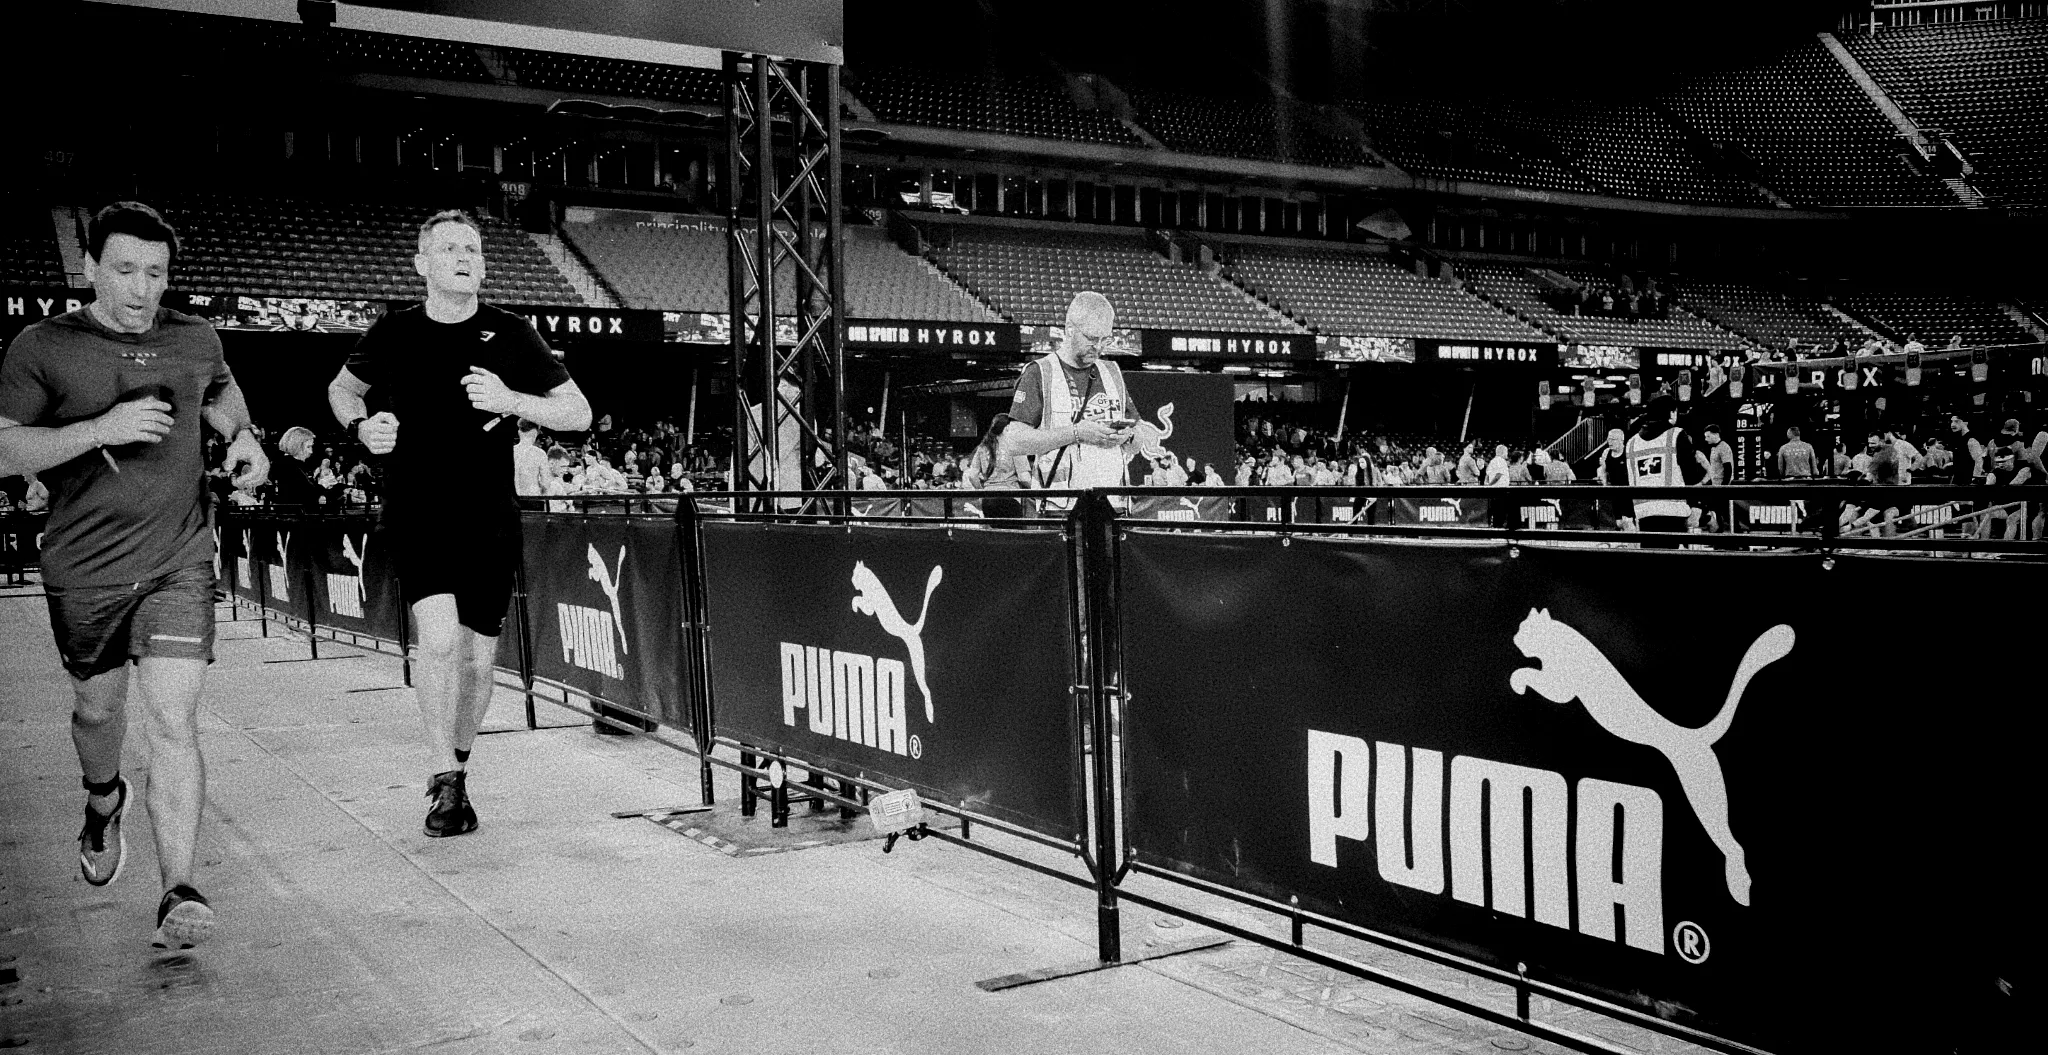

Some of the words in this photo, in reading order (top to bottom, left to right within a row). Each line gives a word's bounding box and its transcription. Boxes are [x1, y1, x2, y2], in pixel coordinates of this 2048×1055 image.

[917, 328, 996, 346] HYROX
[1227, 339, 1291, 355] HYROX
[1484, 346, 1538, 362] HYROX
[1419, 506, 1456, 521] PUMA
[557, 602, 618, 679] PUMA
[780, 641, 908, 757] PUMA
[1307, 728, 1666, 956] PUMA
